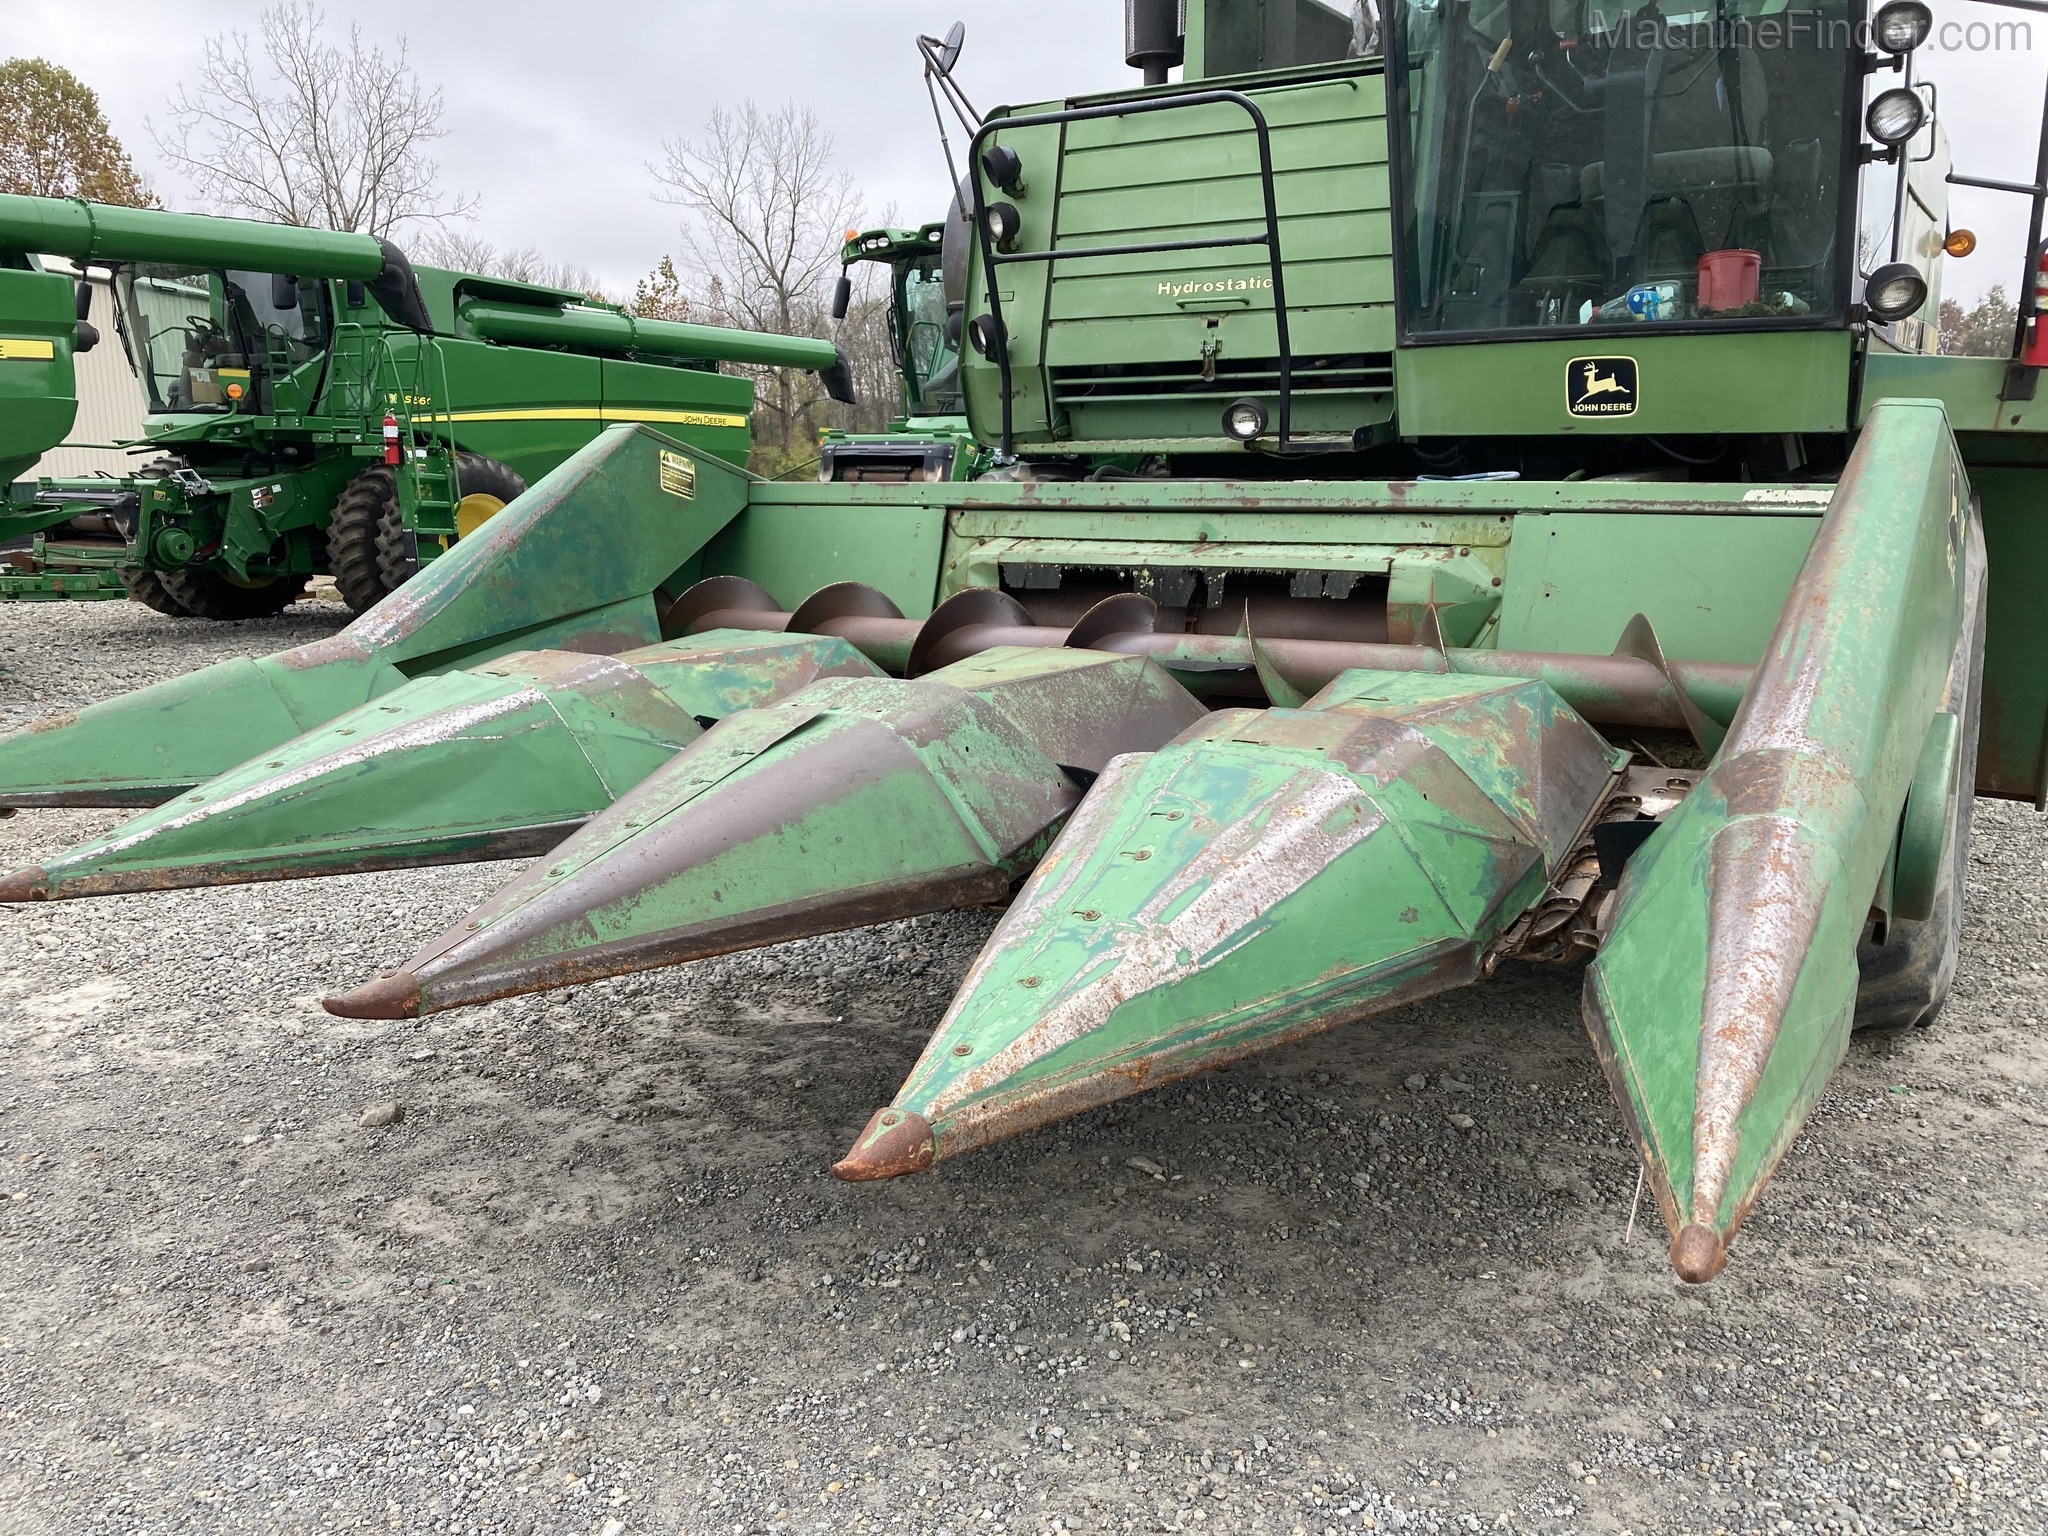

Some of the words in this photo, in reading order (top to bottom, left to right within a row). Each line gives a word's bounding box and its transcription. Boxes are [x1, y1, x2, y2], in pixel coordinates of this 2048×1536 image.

[1157, 275, 1273, 297] Hydrostatic
[1572, 403, 1599, 412] JOHN
[1600, 402, 1633, 411] DEERE
[683, 414, 703, 424] JOHN
[704, 415, 727, 426] DEERE
